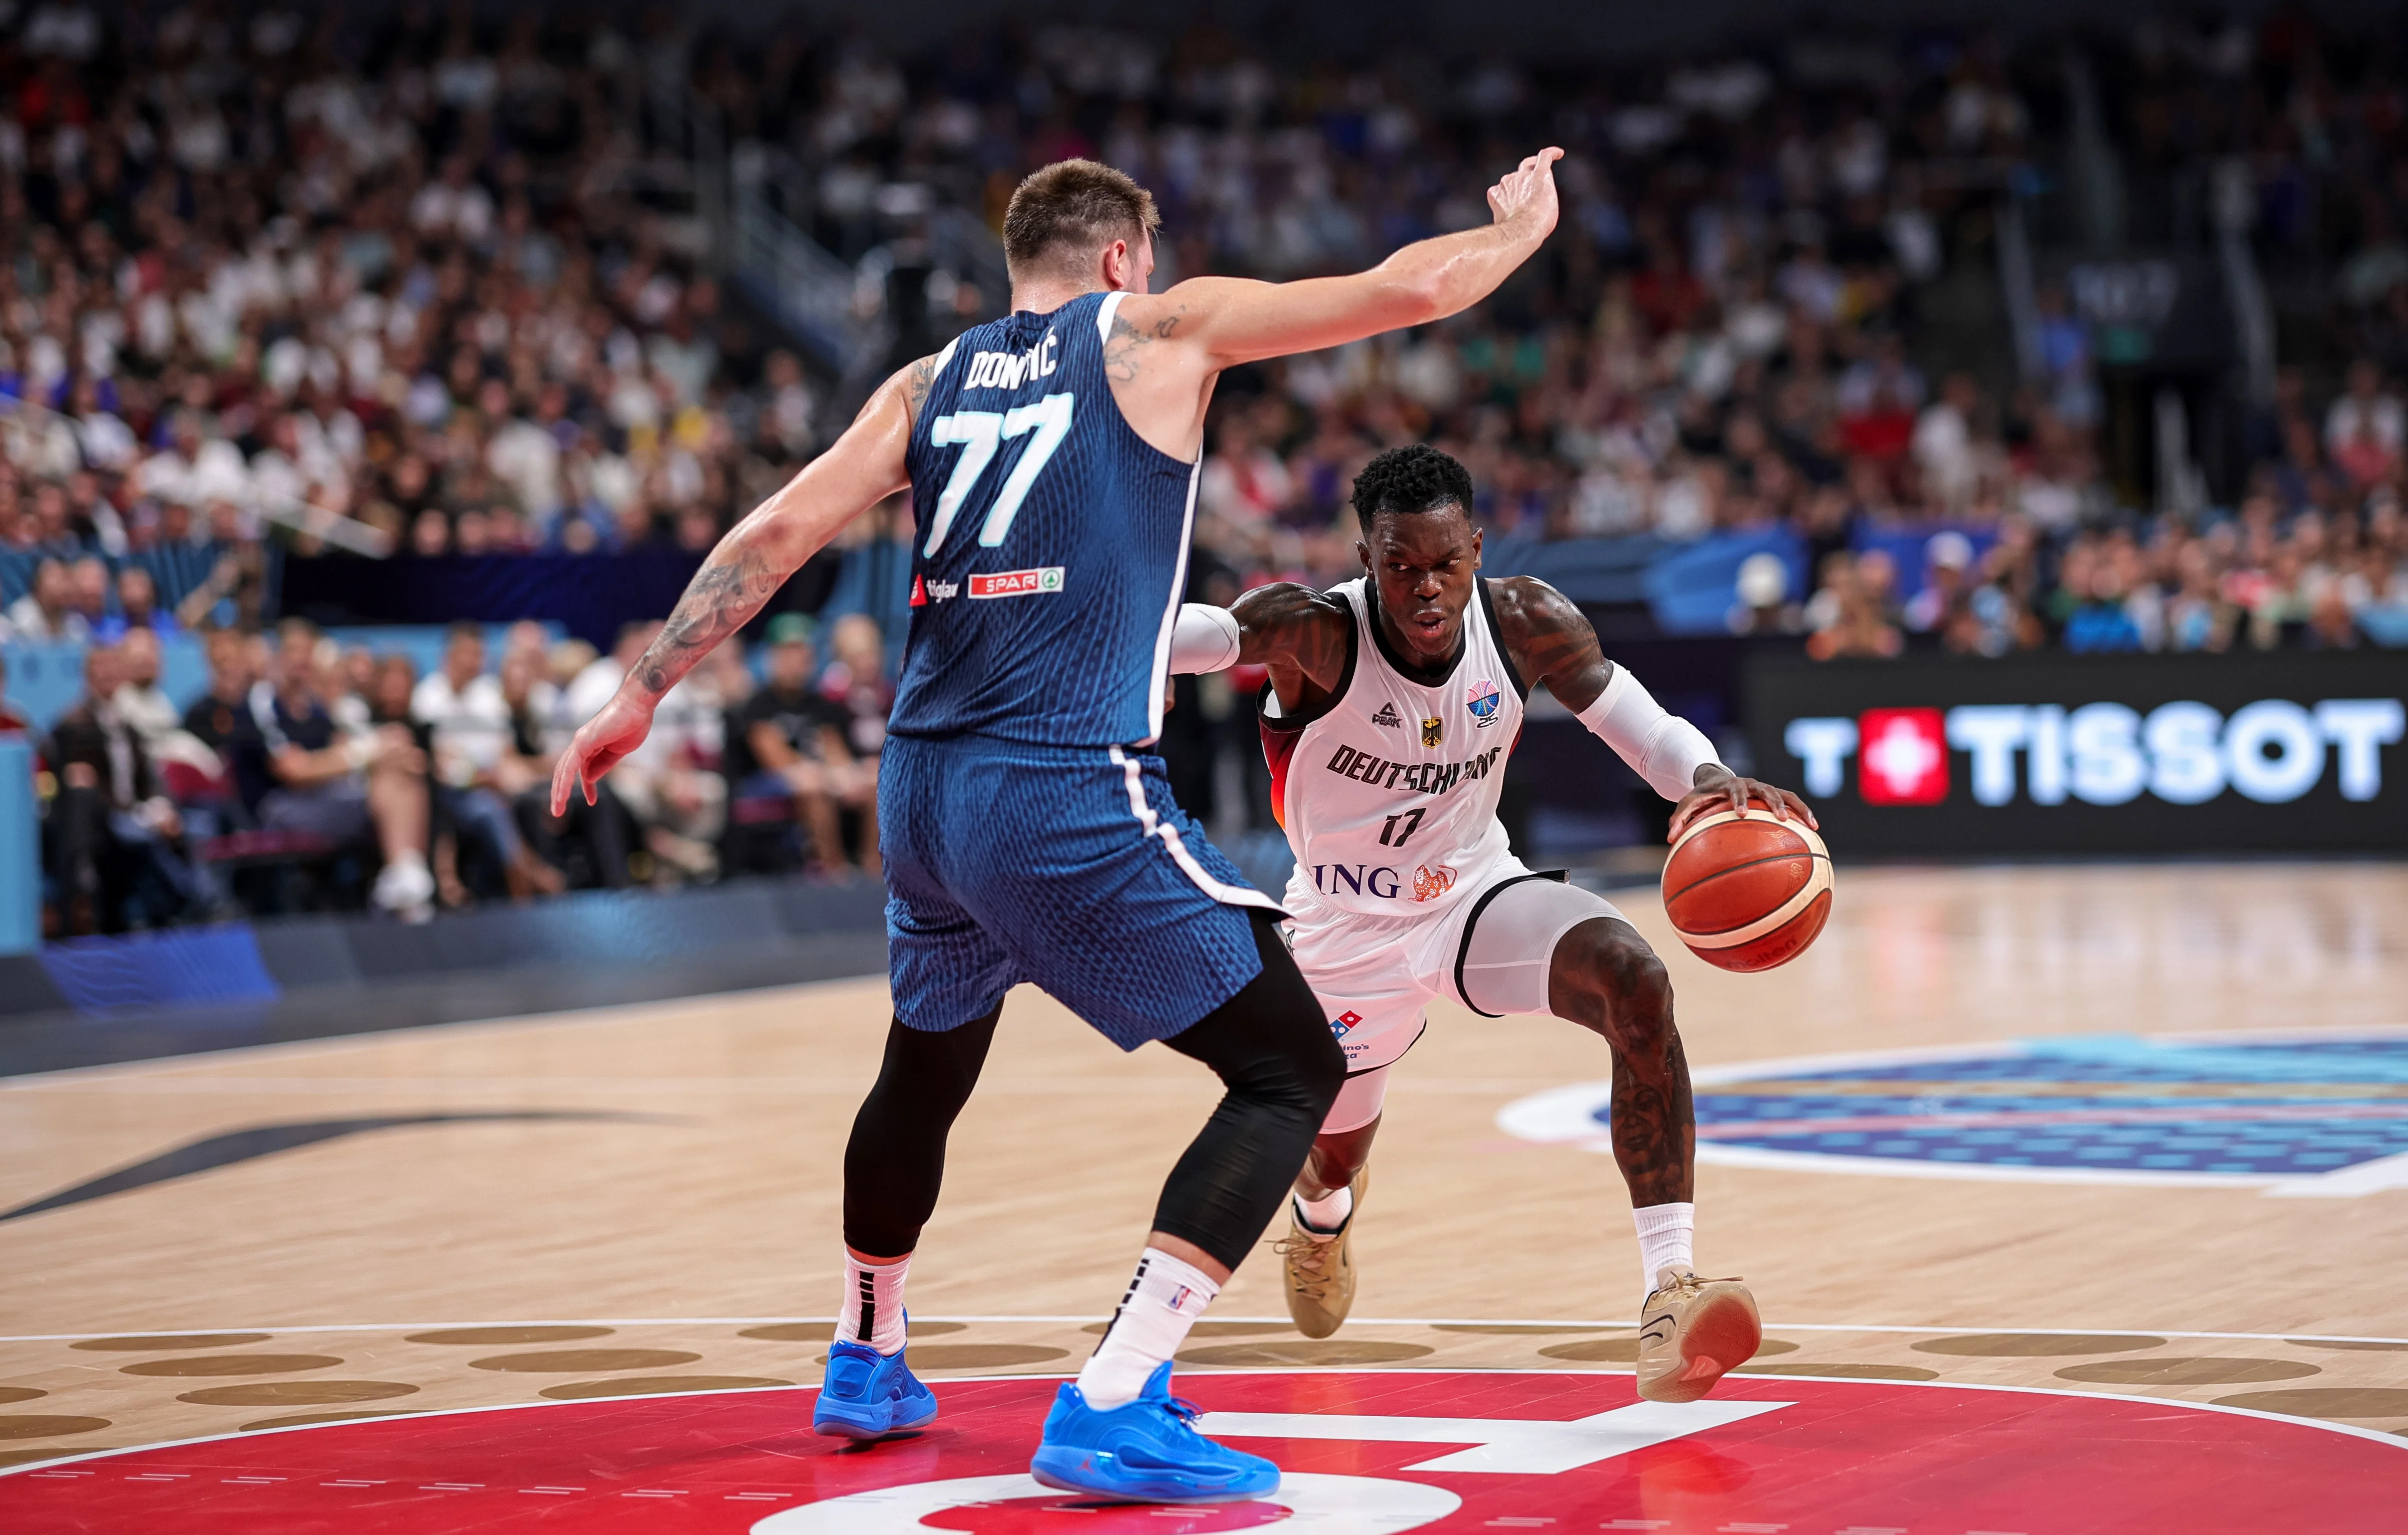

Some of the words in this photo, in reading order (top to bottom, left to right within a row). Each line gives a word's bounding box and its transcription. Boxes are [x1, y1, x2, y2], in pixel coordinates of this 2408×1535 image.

[963, 325, 1057, 391] DONIĆ
[923, 392, 1074, 559] 77
[986, 574, 1036, 593] SPAR
[1372, 713, 1402, 729] PEAK
[1477, 712, 1499, 728] 25
[1947, 699, 2406, 805] TISSOT
[1378, 807, 1427, 848] 17
[1312, 864, 1402, 899] ING
